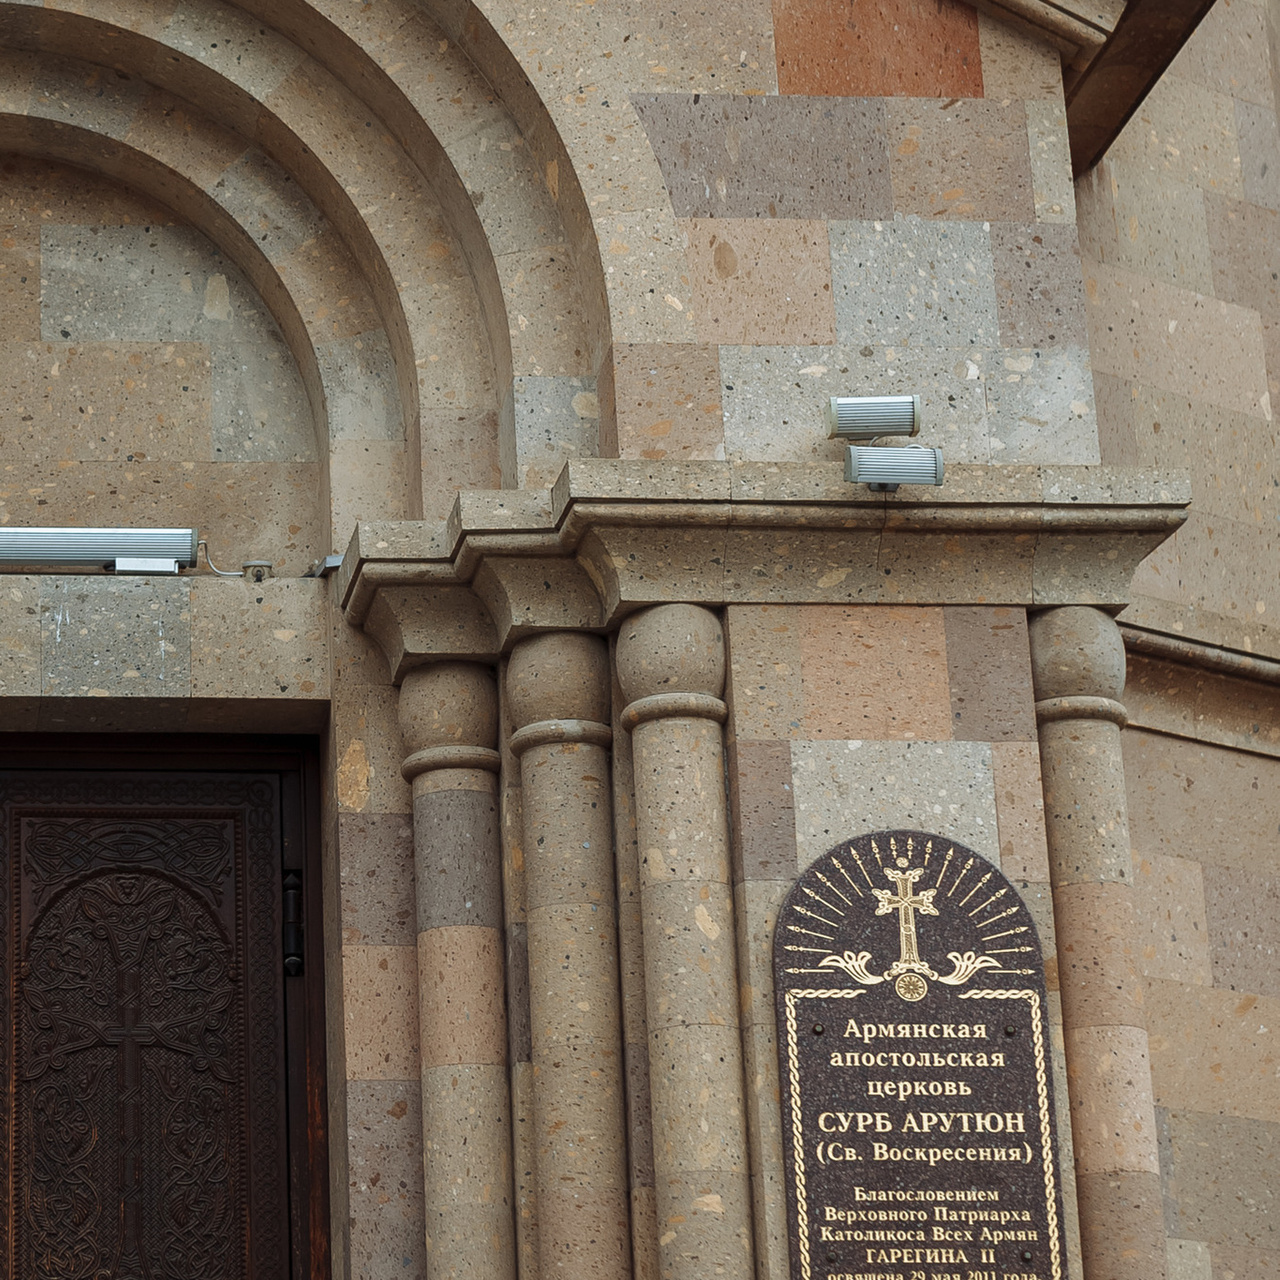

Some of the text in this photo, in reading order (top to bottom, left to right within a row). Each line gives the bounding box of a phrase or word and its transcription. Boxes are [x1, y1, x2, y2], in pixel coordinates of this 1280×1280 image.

[843, 1019, 987, 1043] Армянская
[830, 1052, 1005, 1066] апостольская
[867, 1080, 972, 1100] церковь
[818, 1112, 1025, 1133] СУРБ АРУТЮН
[816, 1142, 1033, 1165] (Св. Воскресения)
[854, 1187, 999, 1201] Благословением
[825, 1207, 1031, 1224] Верховного Патриарха
[820, 1227, 1038, 1243] Католикоса Всех Армян
[866, 1249, 995, 1263] ГАРЕГИНА II
